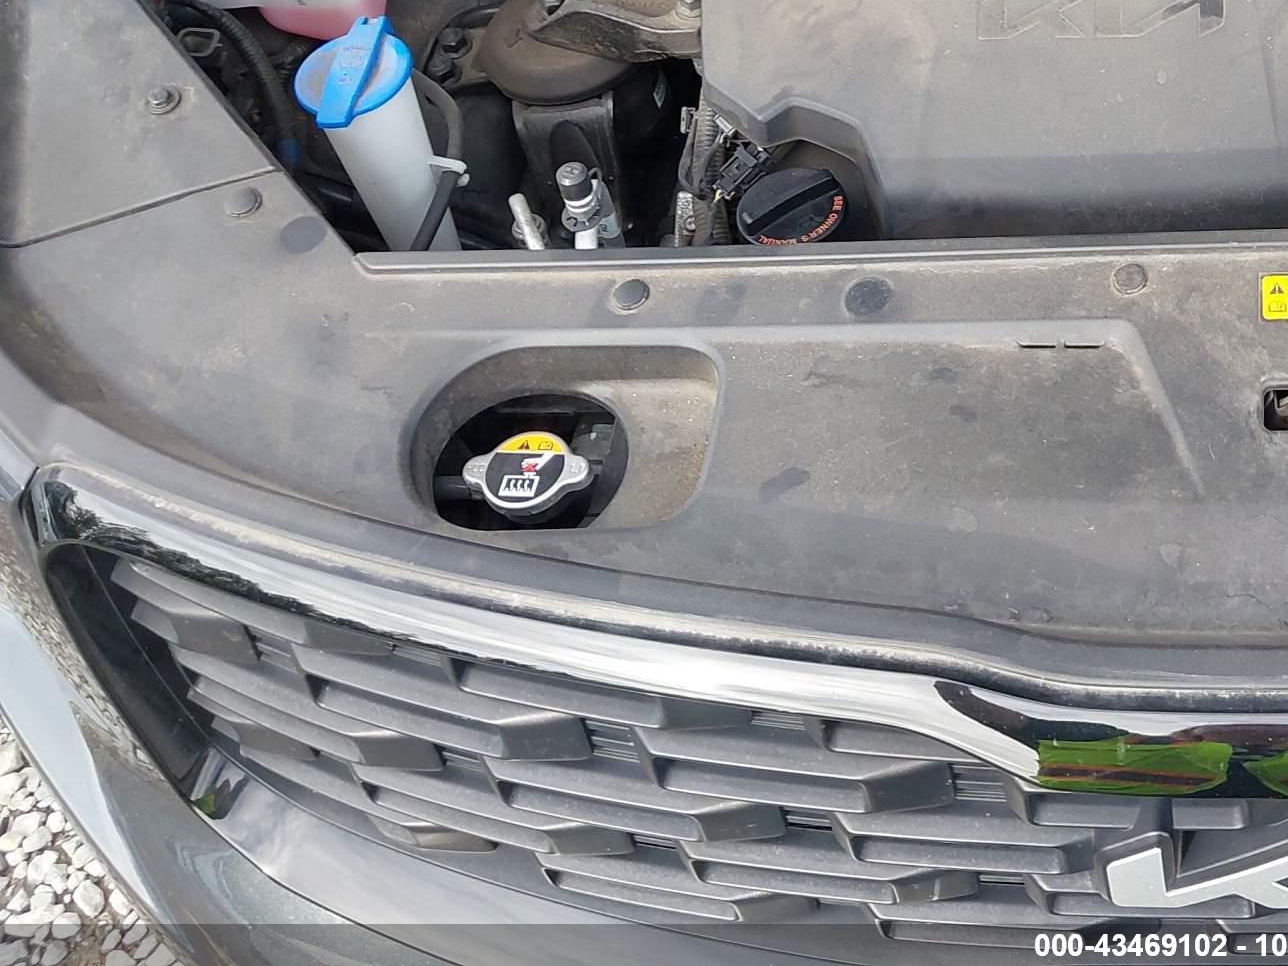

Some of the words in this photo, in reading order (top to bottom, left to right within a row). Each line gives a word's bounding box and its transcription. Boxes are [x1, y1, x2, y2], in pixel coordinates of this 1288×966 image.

[832, 195, 844, 211] SEE
[800, 212, 839, 243] OWNER'S
[758, 234, 798, 246] MANUAL
